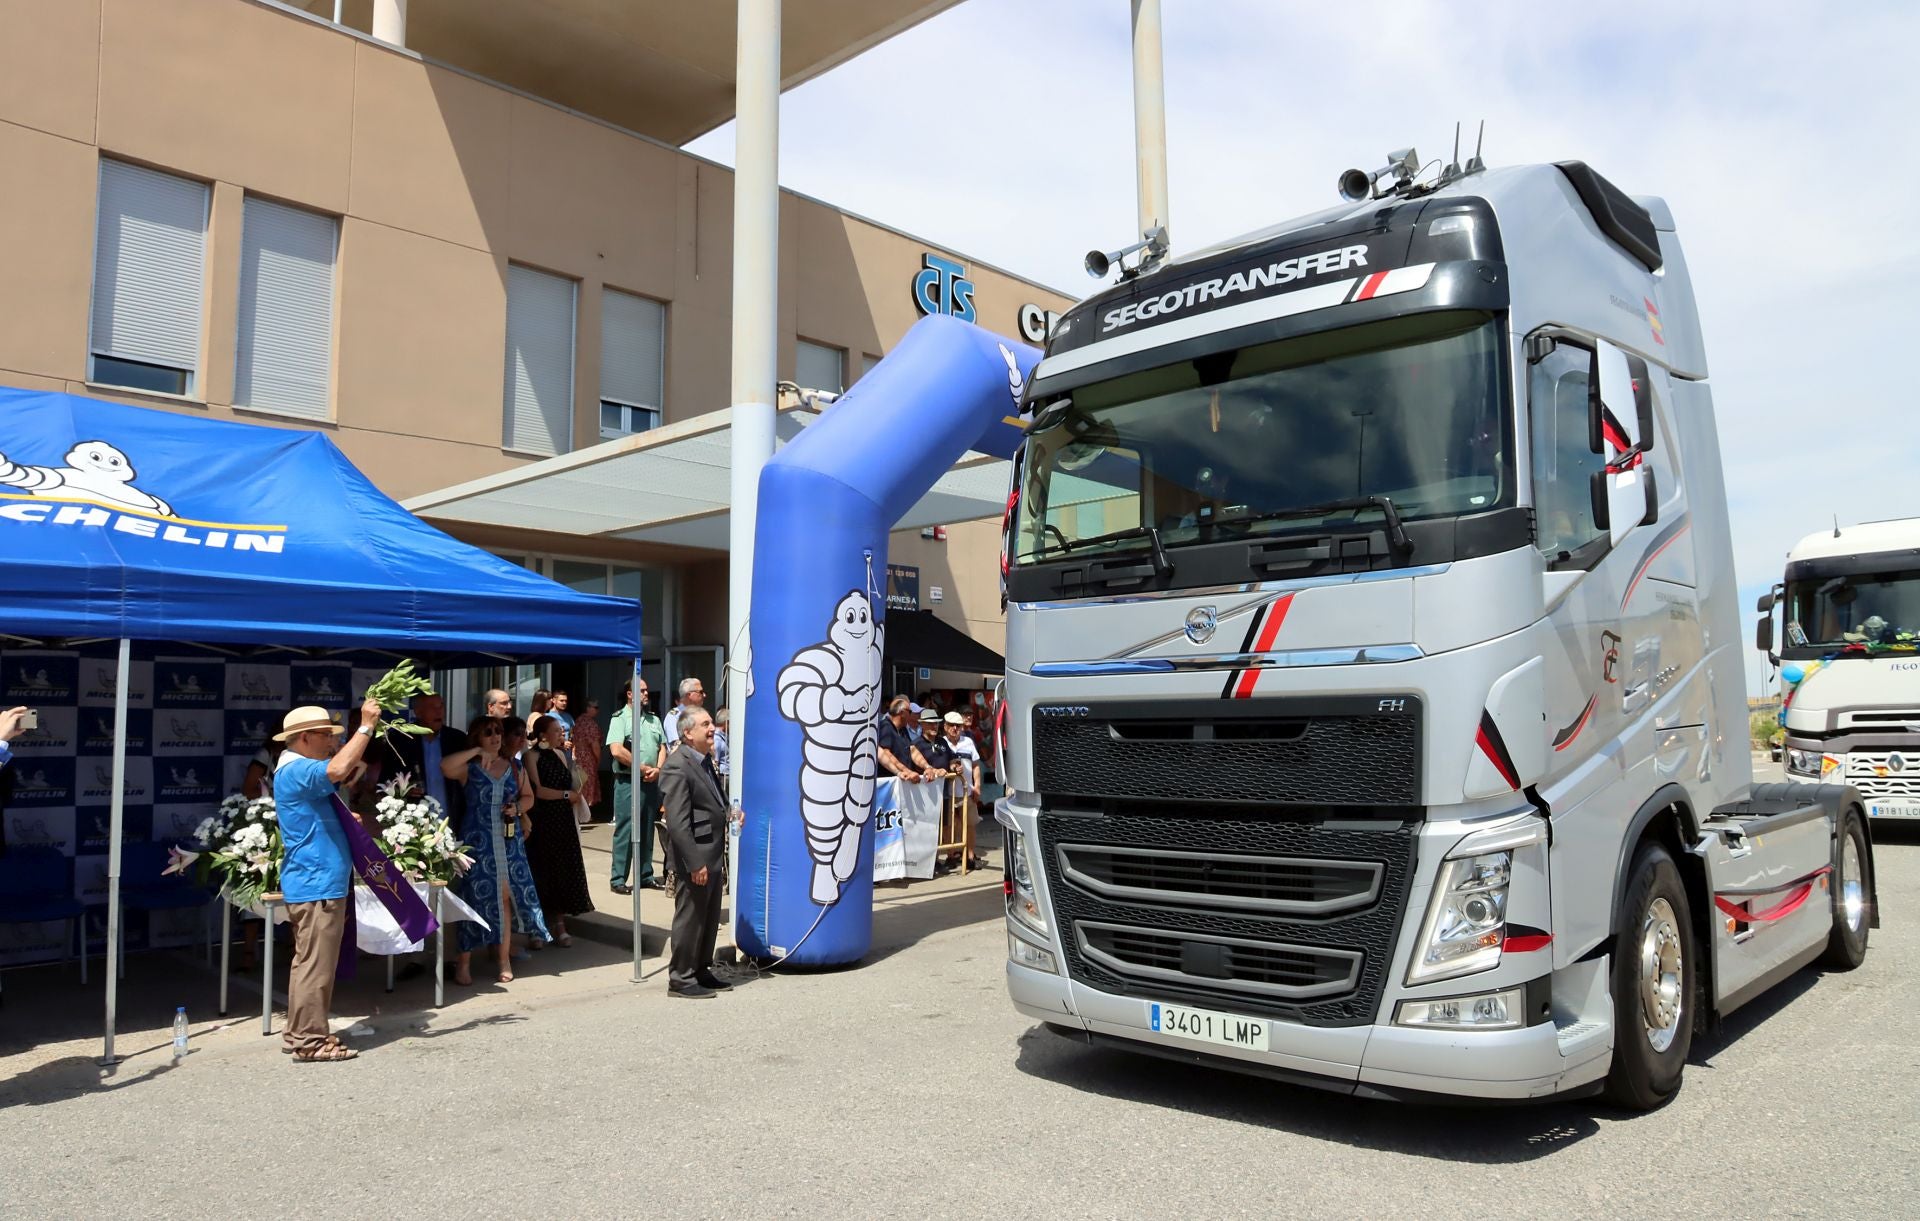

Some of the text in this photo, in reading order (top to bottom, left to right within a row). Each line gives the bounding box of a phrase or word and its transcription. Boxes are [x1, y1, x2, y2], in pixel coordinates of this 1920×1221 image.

[912, 253, 976, 324] CTS
[1102, 244, 1369, 332] SEGOTRANSFER
[886, 594, 910, 604] ARNES
[1038, 705, 1089, 717] VOLVO
[1378, 699, 1405, 711] FH
[161, 787, 216, 795] MICHELIN
[1878, 807, 1920, 816] 9181 LC
[1165, 1009, 1212, 1038] 3401
[1223, 1018, 1262, 1045] LMP
